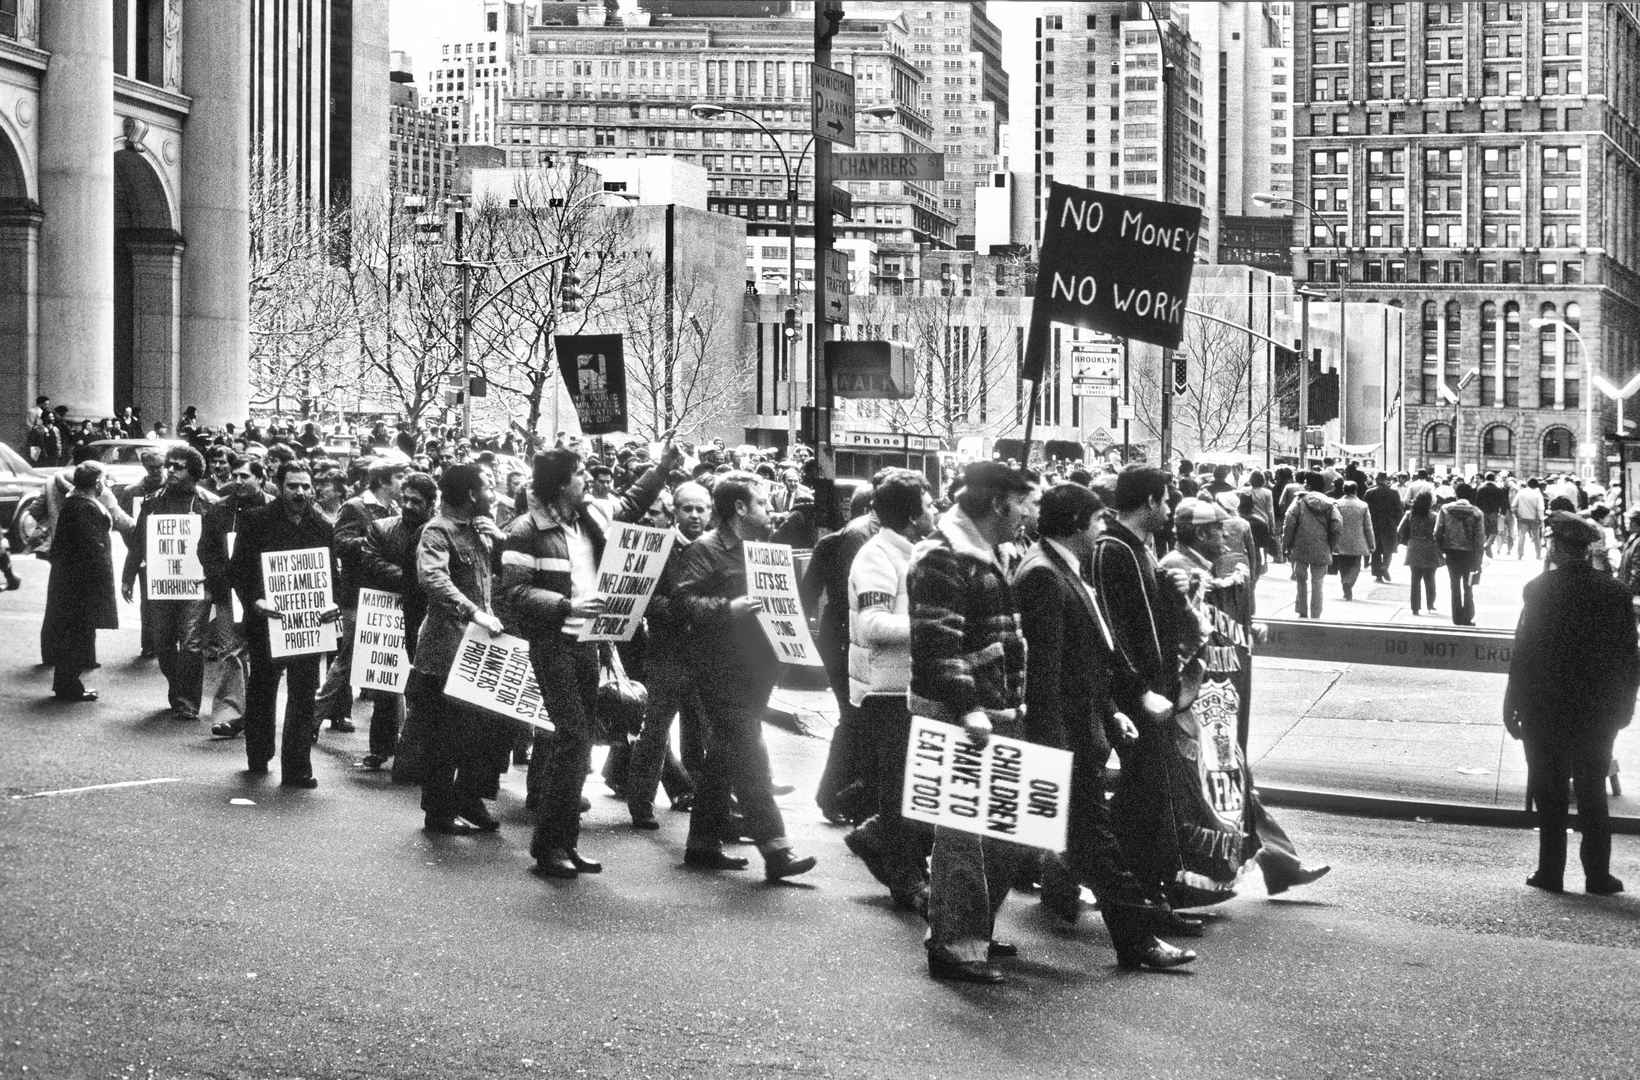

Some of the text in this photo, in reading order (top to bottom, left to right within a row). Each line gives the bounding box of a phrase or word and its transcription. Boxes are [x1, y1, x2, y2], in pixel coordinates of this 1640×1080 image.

[814, 71, 852, 97] MUNICIPAL
[815, 91, 852, 128] PARKING
[840, 156, 940, 176] CHAMBERS ST
[1061, 197, 1195, 253] NO MONEY
[825, 276, 847, 296] TRAFFIC
[1051, 271, 1183, 324] NO WORK
[1074, 355, 1117, 364] BROOKLYN
[575, 401, 619, 409] MPLOYEES
[589, 393, 618, 401] PUBLIC
[853, 435, 900, 446] Phone
[157, 519, 191, 535] KEEP US
[158, 539, 188, 555] OUT OF
[618, 527, 666, 553] NEW YORK
[268, 552, 324, 573] WHY SHOULD
[623, 552, 649, 574] IS AN
[747, 546, 770, 565] MAYOR
[167, 559, 184, 575] THE
[151, 579, 200, 595] POORHOUSE
[268, 571, 328, 593] OUR FAMILIES
[597, 572, 656, 596] INFLATIONARY
[775, 573, 789, 591] SEE
[274, 591, 326, 612] SUFFER FOR
[362, 592, 393, 610] MAYOR
[281, 611, 322, 631] BANKERS
[367, 612, 405, 631] LET'S SE
[285, 630, 321, 650] PROFIT?
[360, 630, 381, 646] HOW
[370, 650, 398, 668] DOING
[1384, 639, 1408, 656] DO
[1423, 641, 1459, 659] NOT
[456, 639, 487, 683] PROFIT?
[476, 644, 509, 692] BANKERS
[365, 669, 399, 686] IN JULY
[496, 646, 530, 706] SUFFER FOR
[949, 741, 983, 818] HAVE TO
[986, 743, 1022, 835] CHILDREN
[910, 773, 942, 815] TOO!
[1027, 778, 1059, 819] OUR
